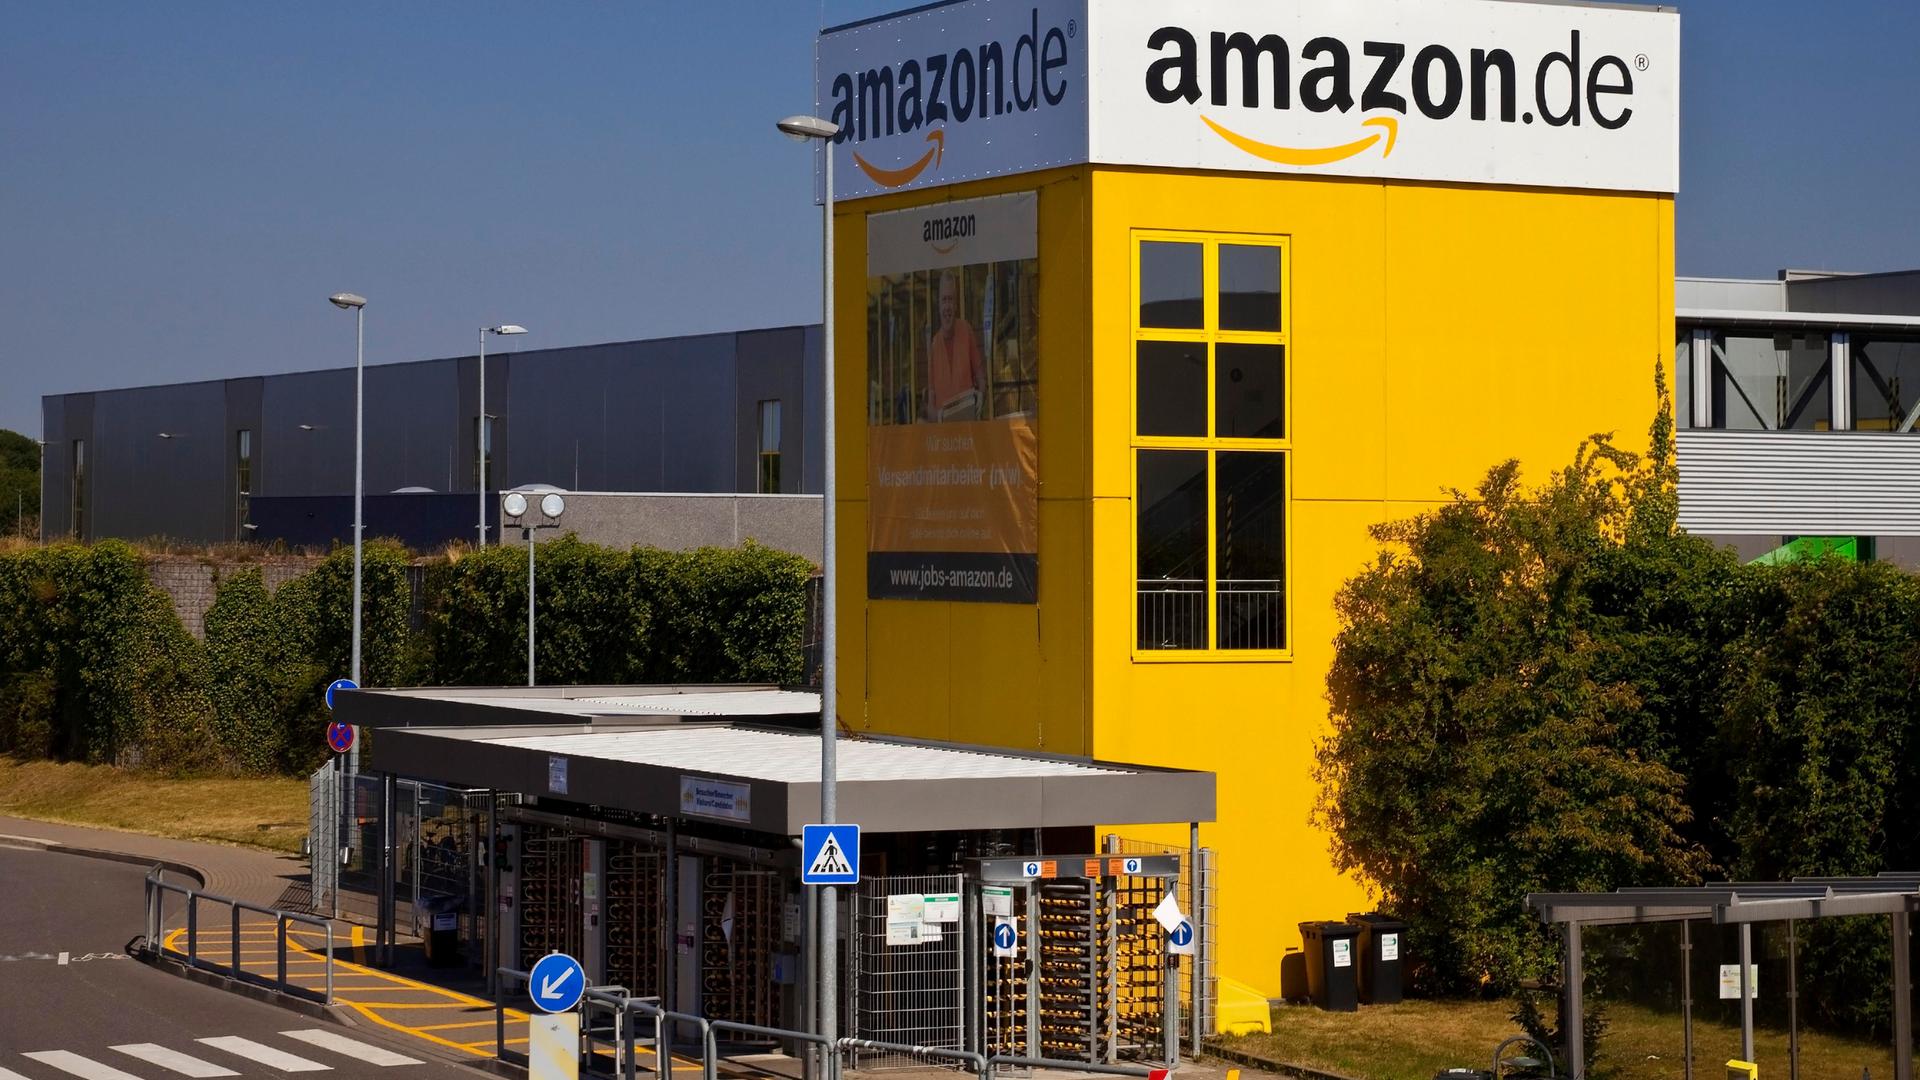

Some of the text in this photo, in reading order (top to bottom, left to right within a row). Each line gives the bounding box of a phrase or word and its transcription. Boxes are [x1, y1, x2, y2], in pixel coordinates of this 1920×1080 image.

[832, 7, 1068, 145] amazon.de
[1145, 25, 1634, 131] amazon.de
[923, 213, 976, 242] amazon
[879, 465, 985, 487] Versandmitarbeiter
[890, 563, 1013, 591] www.jobs-amazon.de
